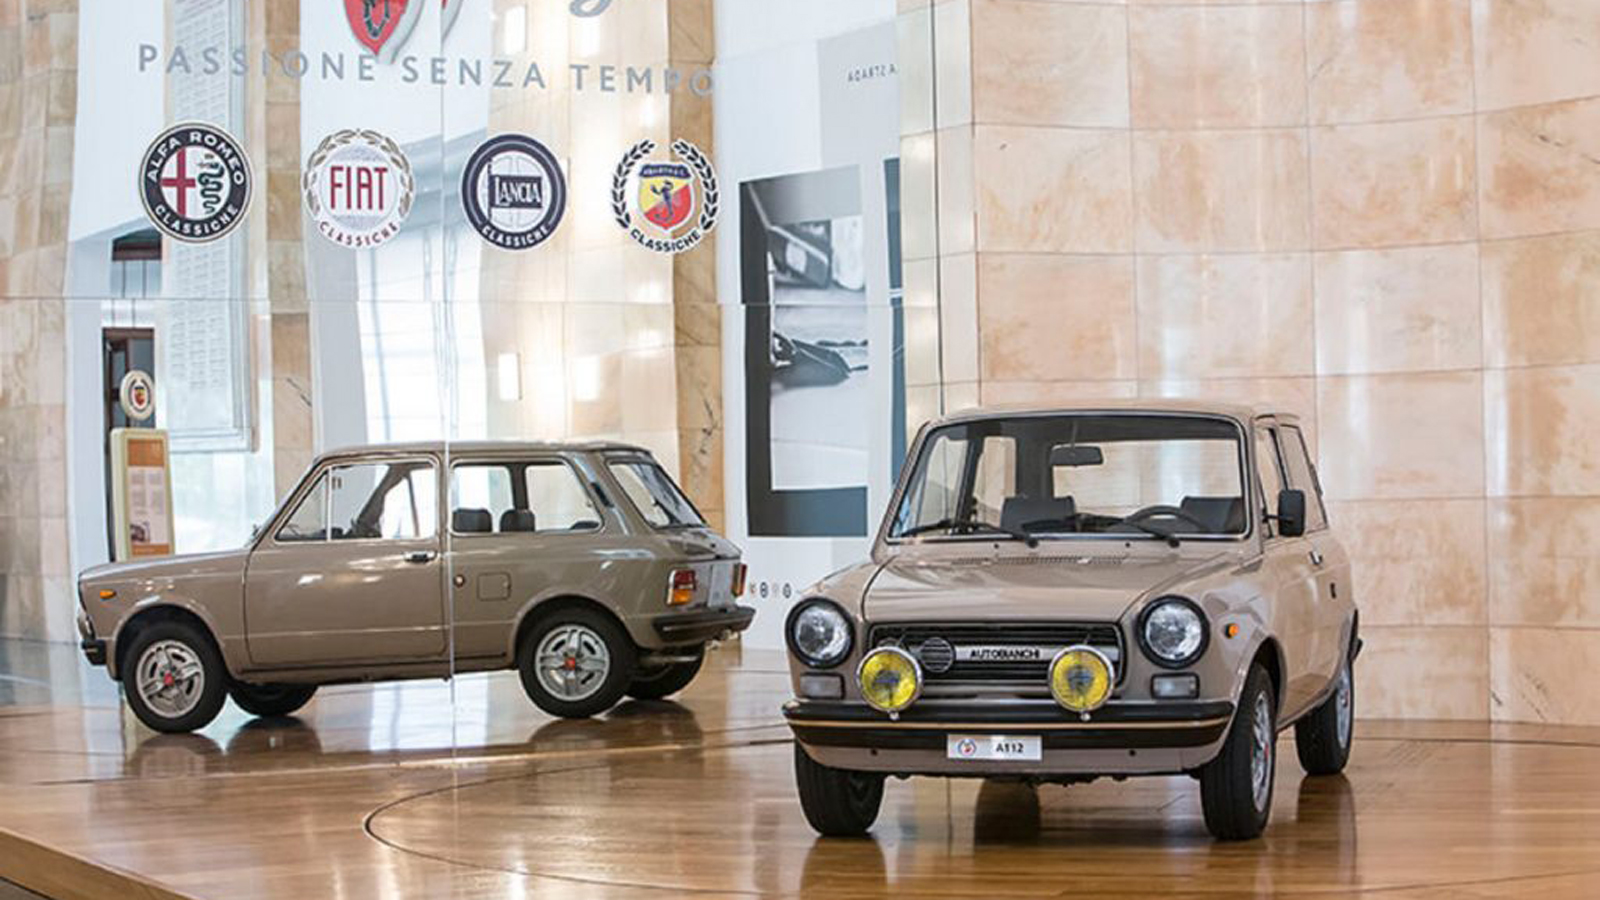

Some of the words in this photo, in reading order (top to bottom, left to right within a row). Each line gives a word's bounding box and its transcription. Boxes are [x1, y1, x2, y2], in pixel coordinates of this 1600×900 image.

[138, 44, 375, 81] PASSIONE
[402, 56, 546, 90] SENZA
[569, 64, 714, 97] TEMPO
[147, 137, 182, 184] ALFA
[189, 131, 245, 186] ROMEO
[330, 165, 389, 211] FIAT
[495, 176, 542, 207] LANCIA
[155, 204, 239, 236] CLASSICHE
[320, 221, 399, 247] CLASSICHE
[481, 224, 550, 247] CLASSICHE
[630, 228, 701, 253] CLASSICHE
[970, 648, 1040, 659] AUTOBIANCHI
[996, 743, 1024, 753] A112
